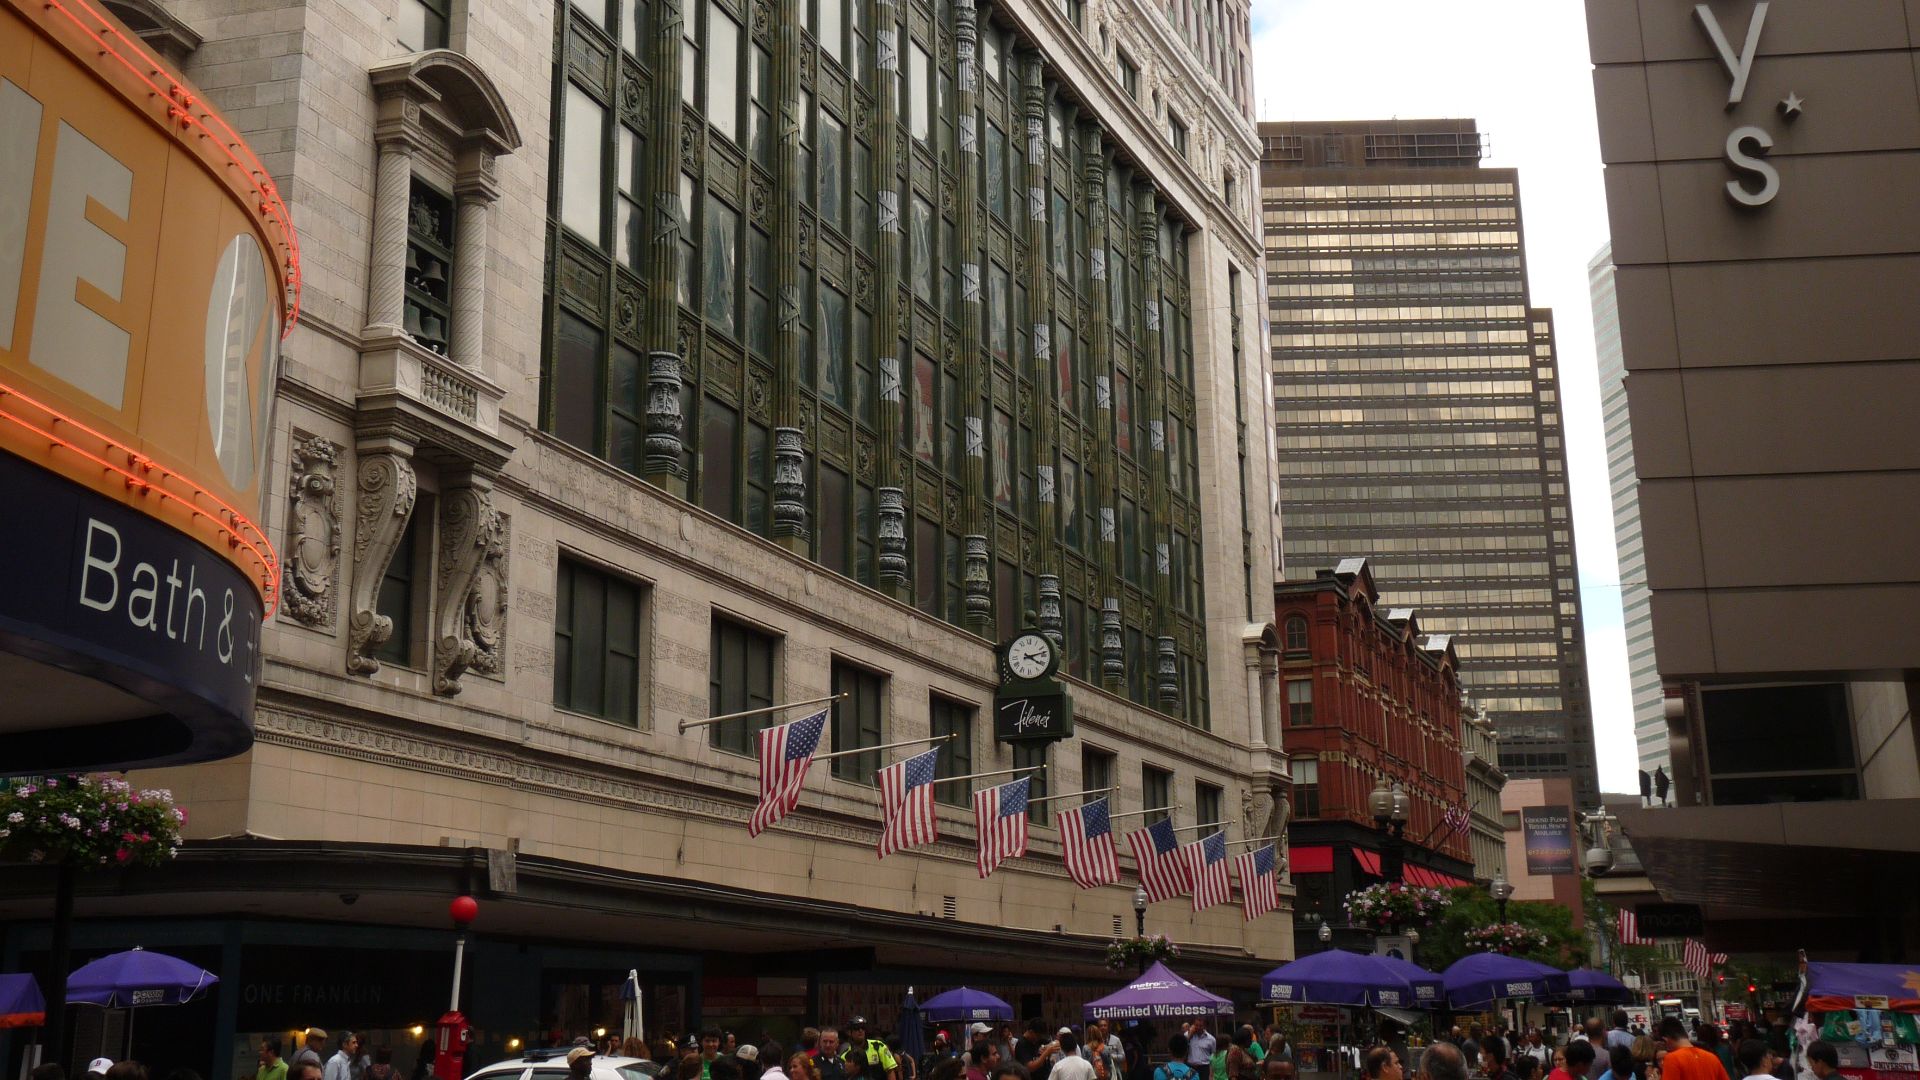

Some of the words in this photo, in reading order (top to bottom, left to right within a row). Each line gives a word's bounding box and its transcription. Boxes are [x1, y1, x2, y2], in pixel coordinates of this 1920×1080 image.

[79, 517, 207, 651] Bath
[217, 587, 235, 668] &
[243, 984, 283, 1004] ONE
[291, 983, 382, 1004] FRANKLIN
[1093, 1004, 1151, 1018] Unlimited
[1153, 1003, 1207, 1016] Wireless
[1873, 1061, 1913, 1071] UNIVERSITY
